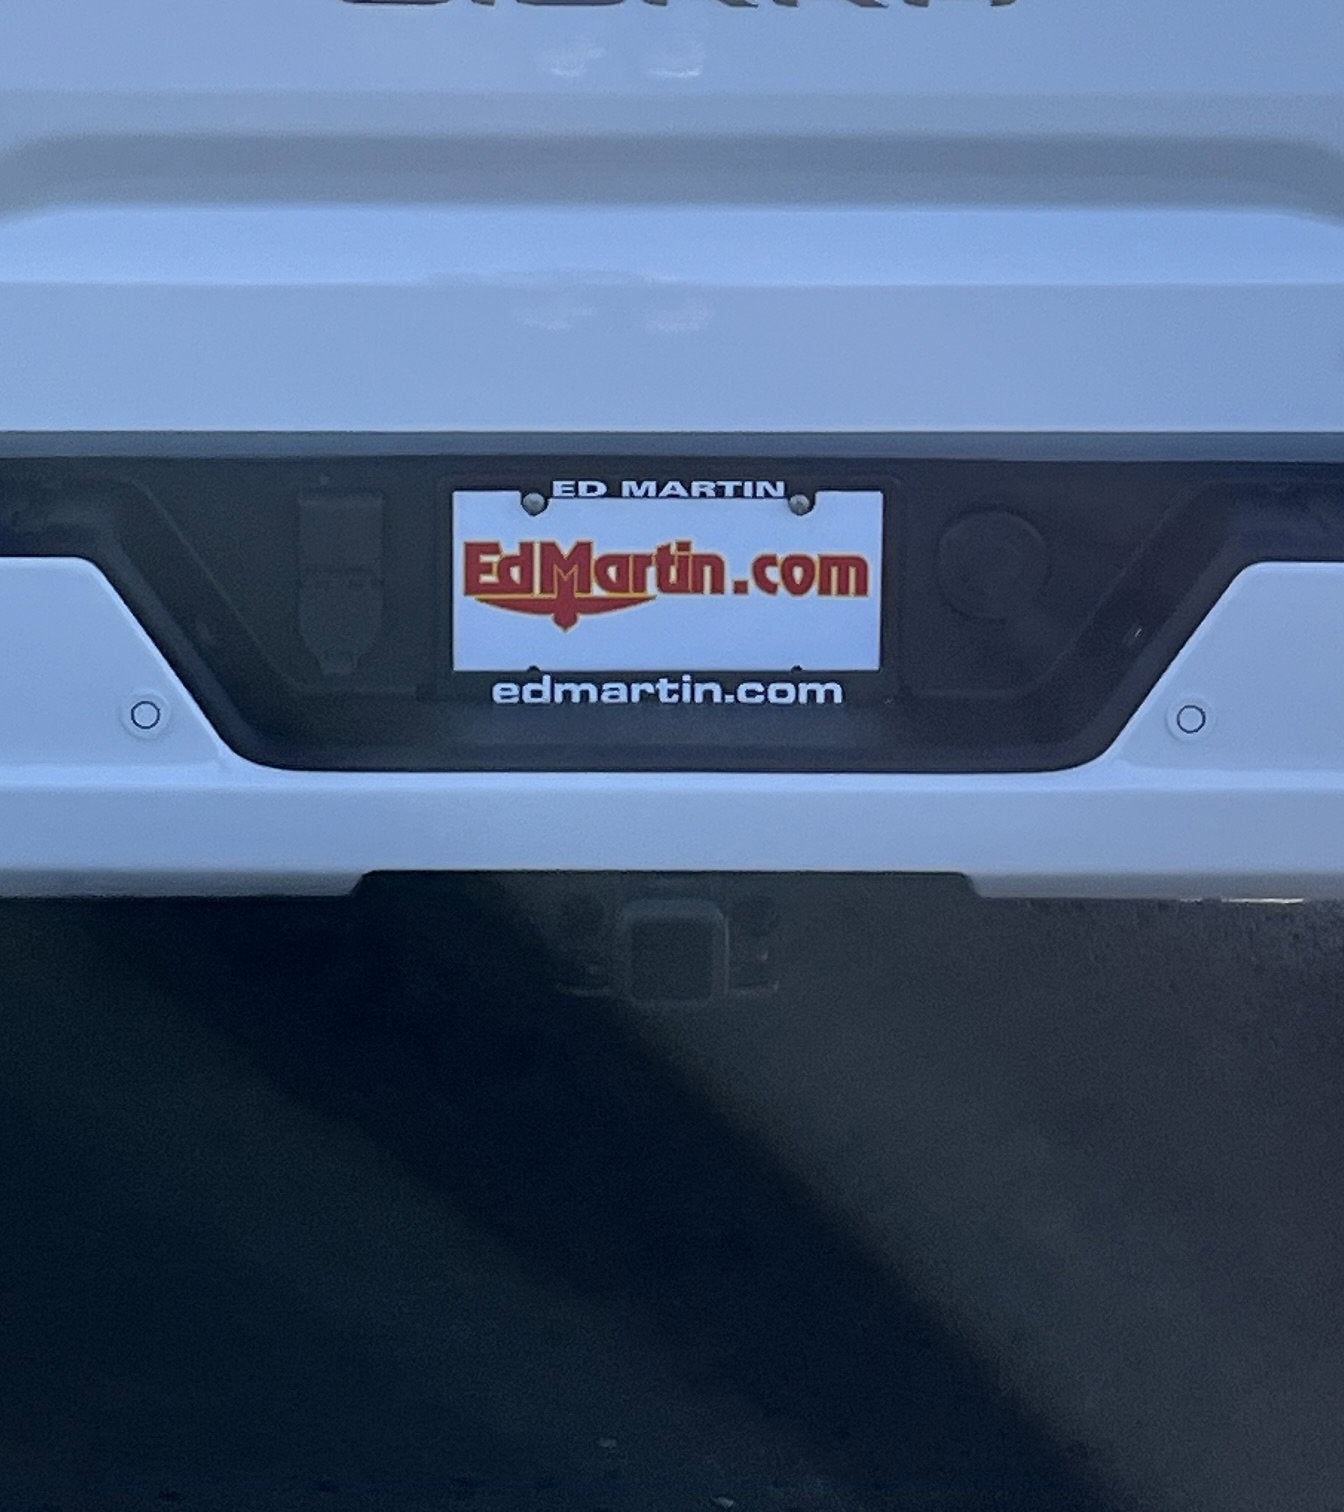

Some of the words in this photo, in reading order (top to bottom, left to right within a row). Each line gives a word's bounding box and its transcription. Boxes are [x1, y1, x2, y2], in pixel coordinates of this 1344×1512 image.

[551, 479, 609, 498] ED
[621, 479, 786, 498] MARTIN
[462, 538, 869, 600] EdMartin.com
[491, 674, 844, 705] edmartin.com
